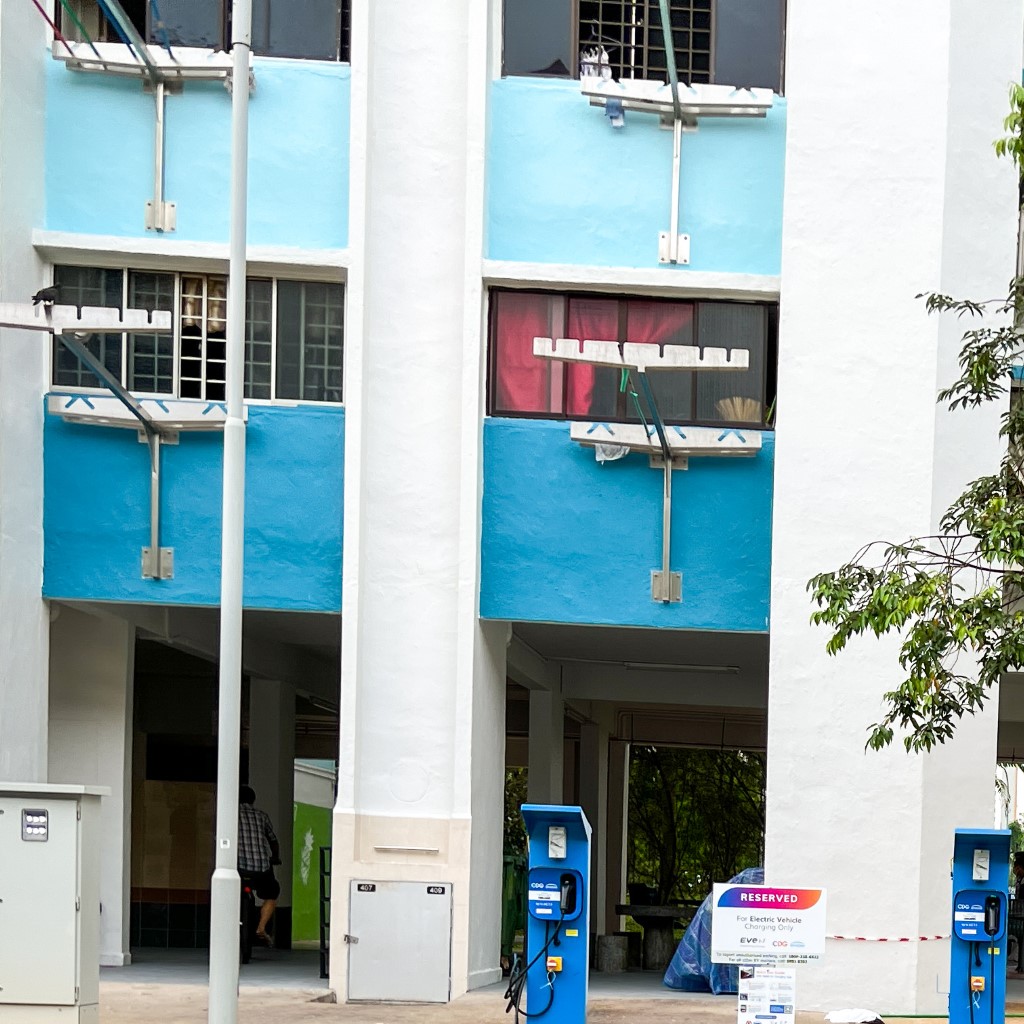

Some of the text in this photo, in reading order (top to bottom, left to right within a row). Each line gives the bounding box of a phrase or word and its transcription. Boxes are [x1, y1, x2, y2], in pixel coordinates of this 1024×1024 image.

[741, 893, 798, 903] RESERVED
[750, 915, 775, 923] Electric
[777, 916, 802, 924] Vehicle
[744, 923, 794, 932] Charging Only
[772, 940, 788, 948] CDG
